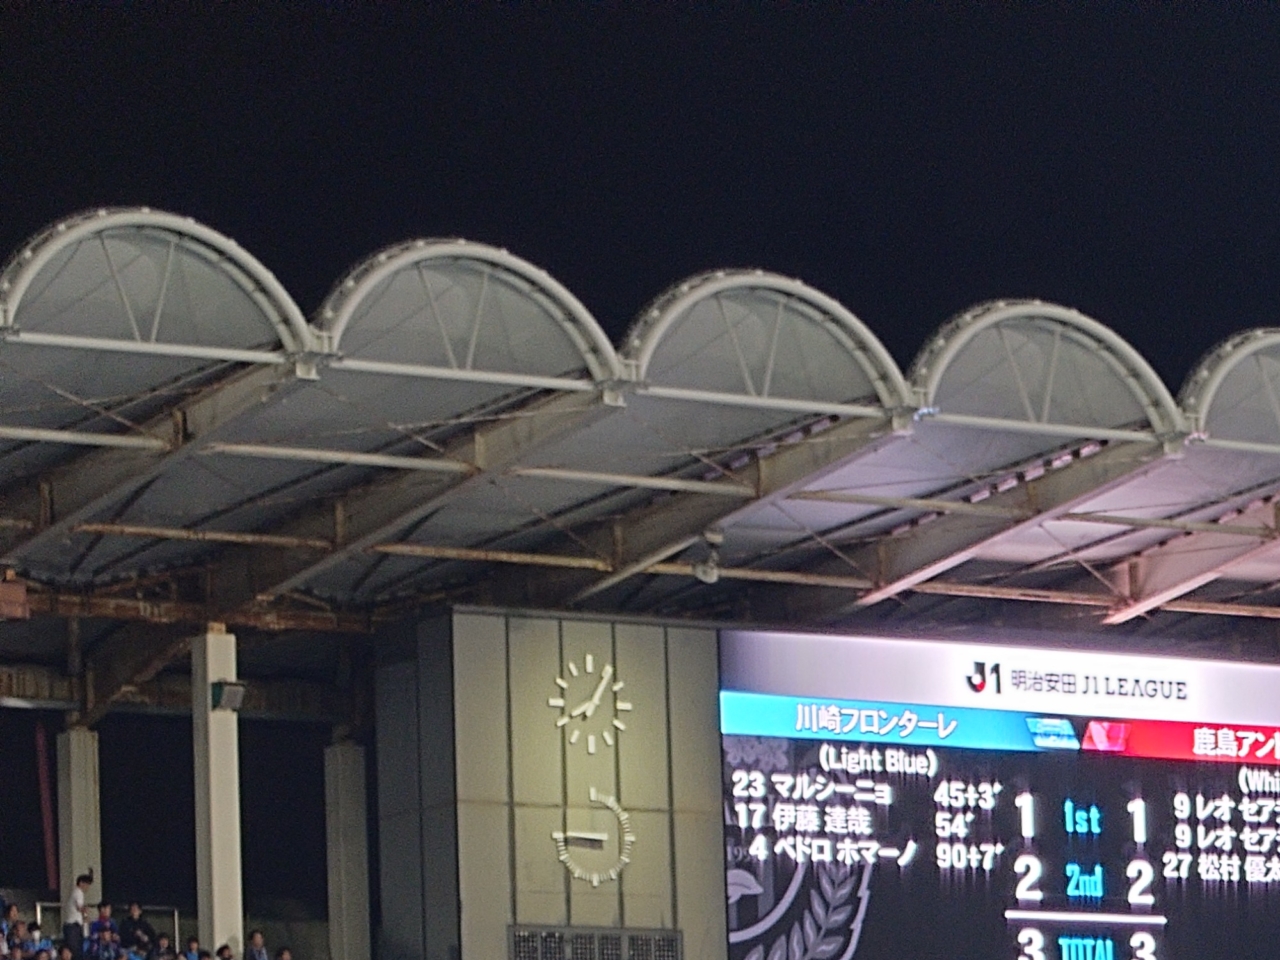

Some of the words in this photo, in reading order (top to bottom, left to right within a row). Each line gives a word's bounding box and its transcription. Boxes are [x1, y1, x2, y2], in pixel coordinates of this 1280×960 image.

[1011, 669, 1077, 694] 明治安田
[1082, 675, 1100, 695] J1
[1104, 676, 1188, 700] LEAGUE
[796, 703, 957, 738] 川崎フロンターレ
[820, 744, 882, 774] (Light
[885, 748, 937, 777] Blue)
[732, 773, 766, 798] 23
[771, 774, 893, 806] マルシーニョ
[934, 781, 1002, 811] 45+3'
[1173, 793, 1191, 819] 9
[1195, 795, 1234, 823] レオ
[734, 803, 766, 829] 17
[772, 804, 820, 834] 伊藤
[824, 806, 872, 835] 達哉
[935, 812, 975, 838] 54'
[1015, 792, 1036, 838] 1
[1064, 799, 1100, 834] 1st
[1127, 798, 1147, 844] 1
[749, 833, 769, 861] 4
[836, 838, 917, 866] ホマーノ
[1175, 824, 1192, 849] 9
[1197, 826, 1236, 852] レオ
[1013, 855, 1044, 901] 2
[1065, 863, 1104, 898] 2nd
[1126, 859, 1155, 905] 2
[1163, 852, 1192, 880] 27
[1198, 853, 1241, 882] 松村
